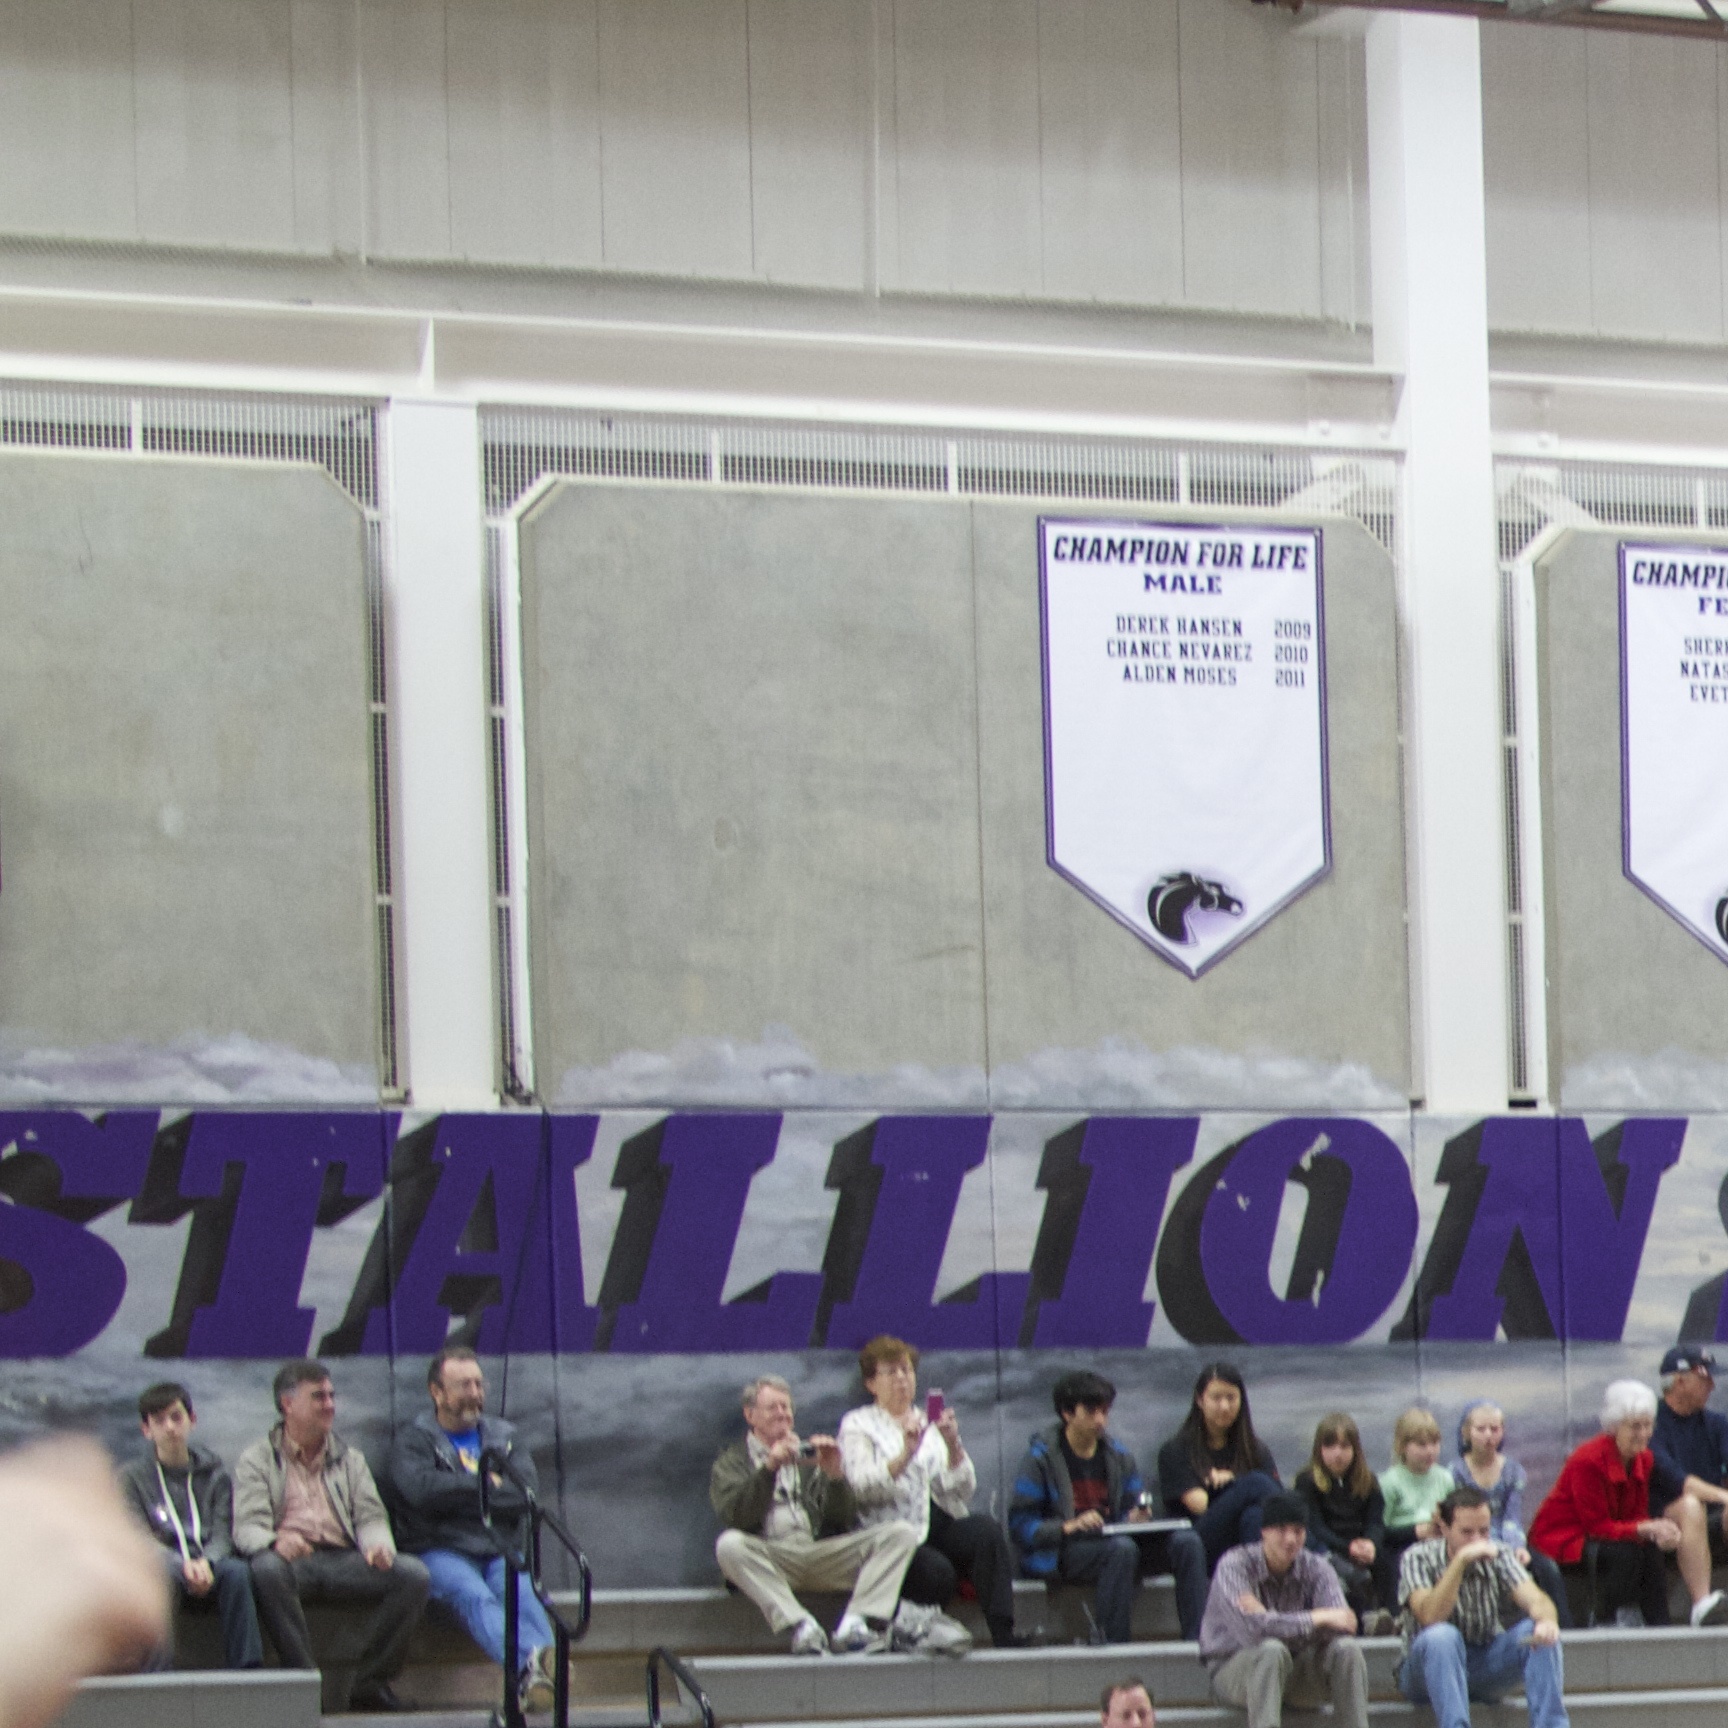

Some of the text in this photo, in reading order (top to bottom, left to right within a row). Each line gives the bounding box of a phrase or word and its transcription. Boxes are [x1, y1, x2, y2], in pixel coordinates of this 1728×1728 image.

[1053, 535, 1309, 570] CHAMPION FOR LIFE
[1143, 573, 1223, 595] MALE
[1116, 615, 1312, 639] DEREK HANSEN 2009
[1106, 640, 1309, 664] CHANCE NEVAREZ 2010
[1122, 665, 1306, 689] ALDEN MOSES 2011
[0, 1110, 1690, 1359] STALLION
